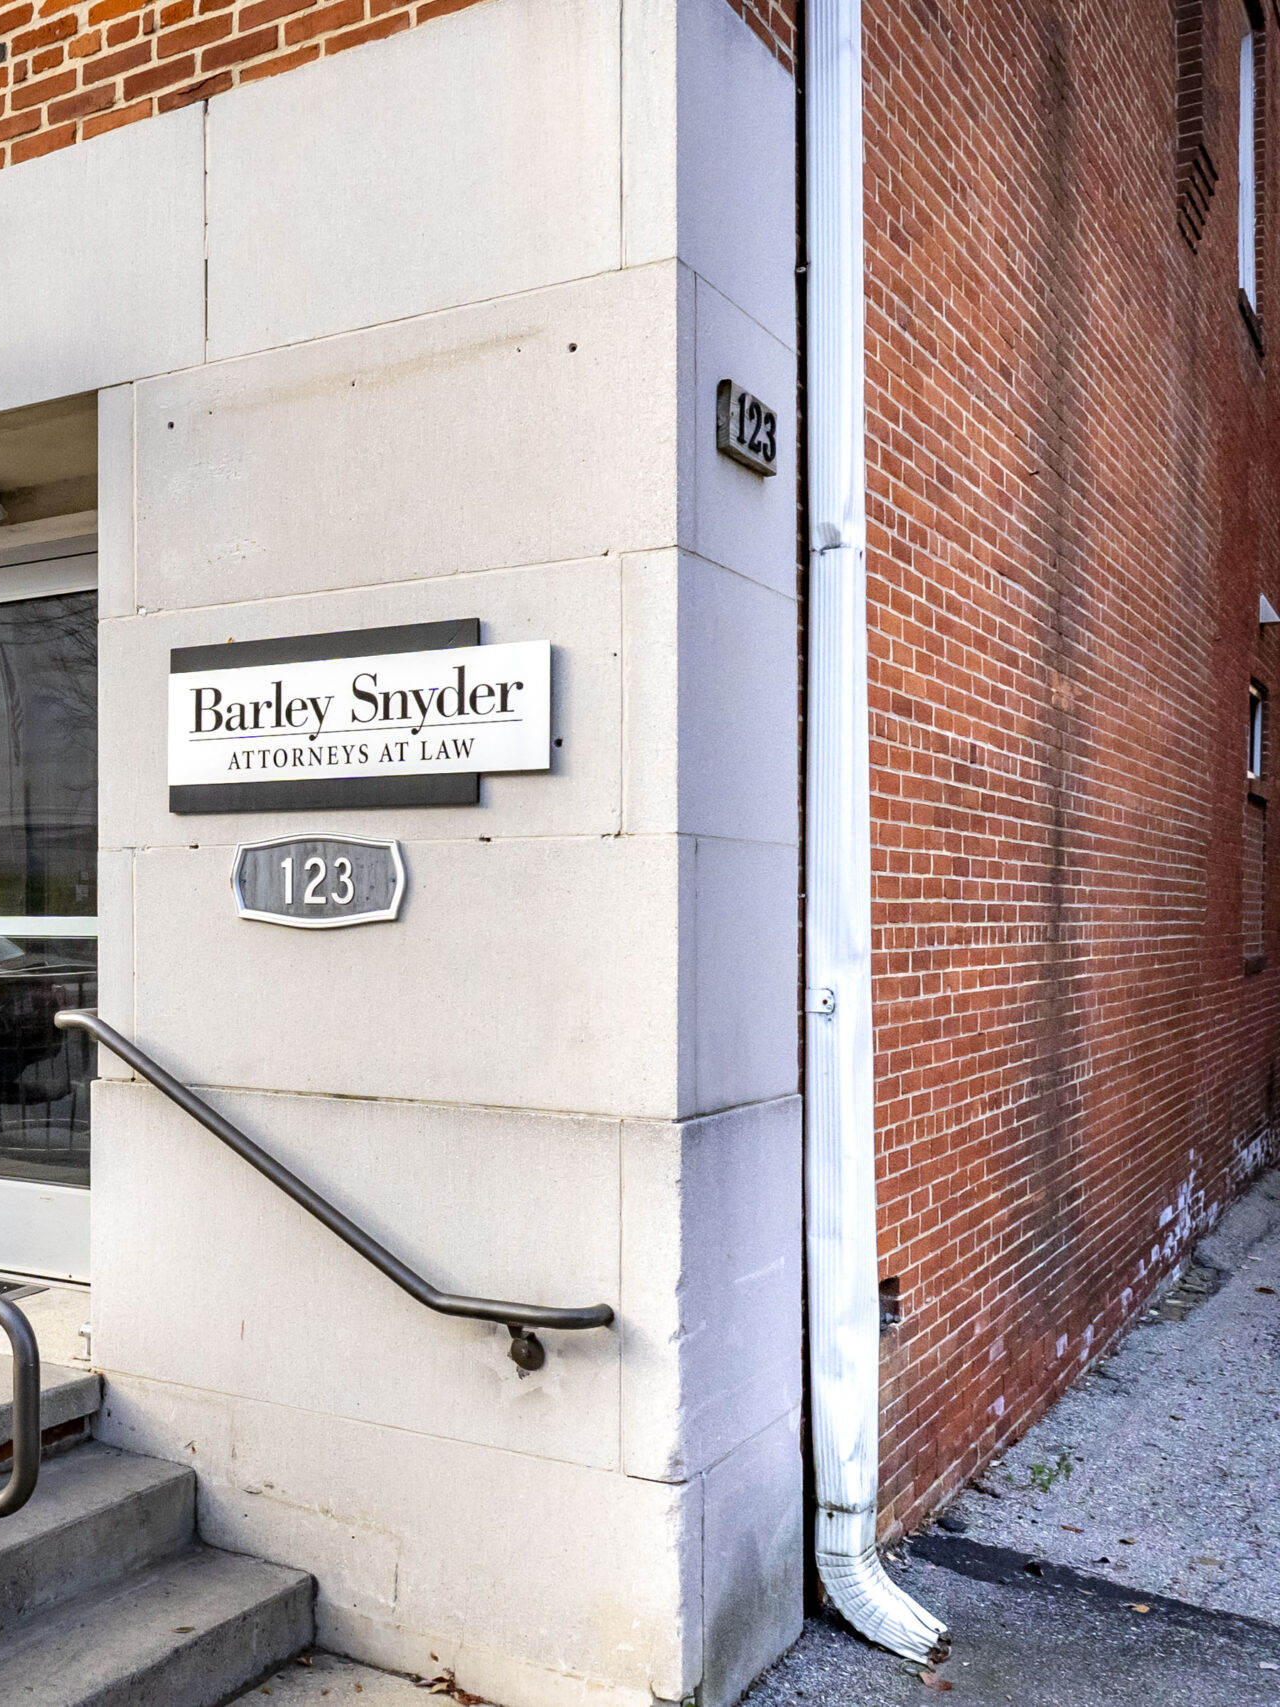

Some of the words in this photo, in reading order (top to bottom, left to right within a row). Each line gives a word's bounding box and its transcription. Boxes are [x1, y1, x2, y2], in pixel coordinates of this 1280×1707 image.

[737, 393, 776, 462] 123
[190, 681, 334, 740] Barley
[351, 665, 524, 734] Snyder
[228, 744, 369, 770] ATTORNEYS
[379, 742, 409, 763] AT
[421, 738, 475, 760] LAW
[281, 857, 355, 905] 123
